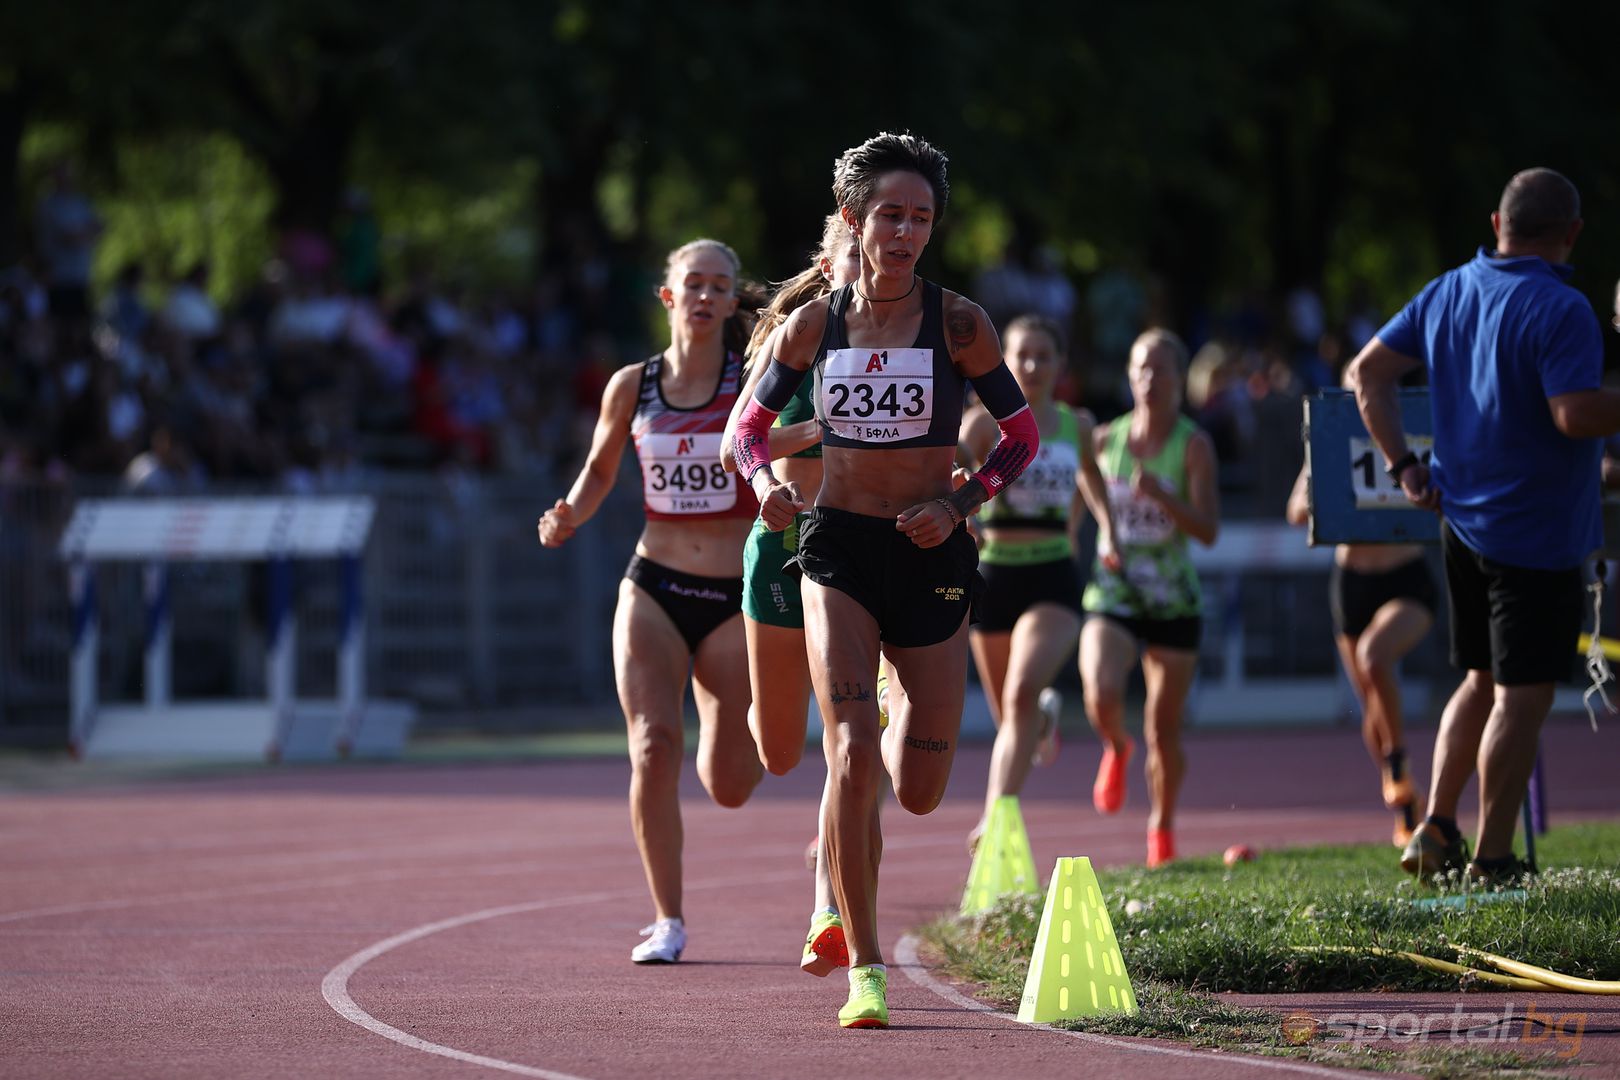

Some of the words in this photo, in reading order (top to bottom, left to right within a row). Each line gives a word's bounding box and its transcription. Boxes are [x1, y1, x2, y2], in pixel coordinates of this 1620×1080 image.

[866, 351, 888, 373] A1
[829, 383, 925, 417] 2343
[866, 428, 900, 438] БФЛА
[677, 437, 694, 456] A1
[651, 463, 729, 492] 3498
